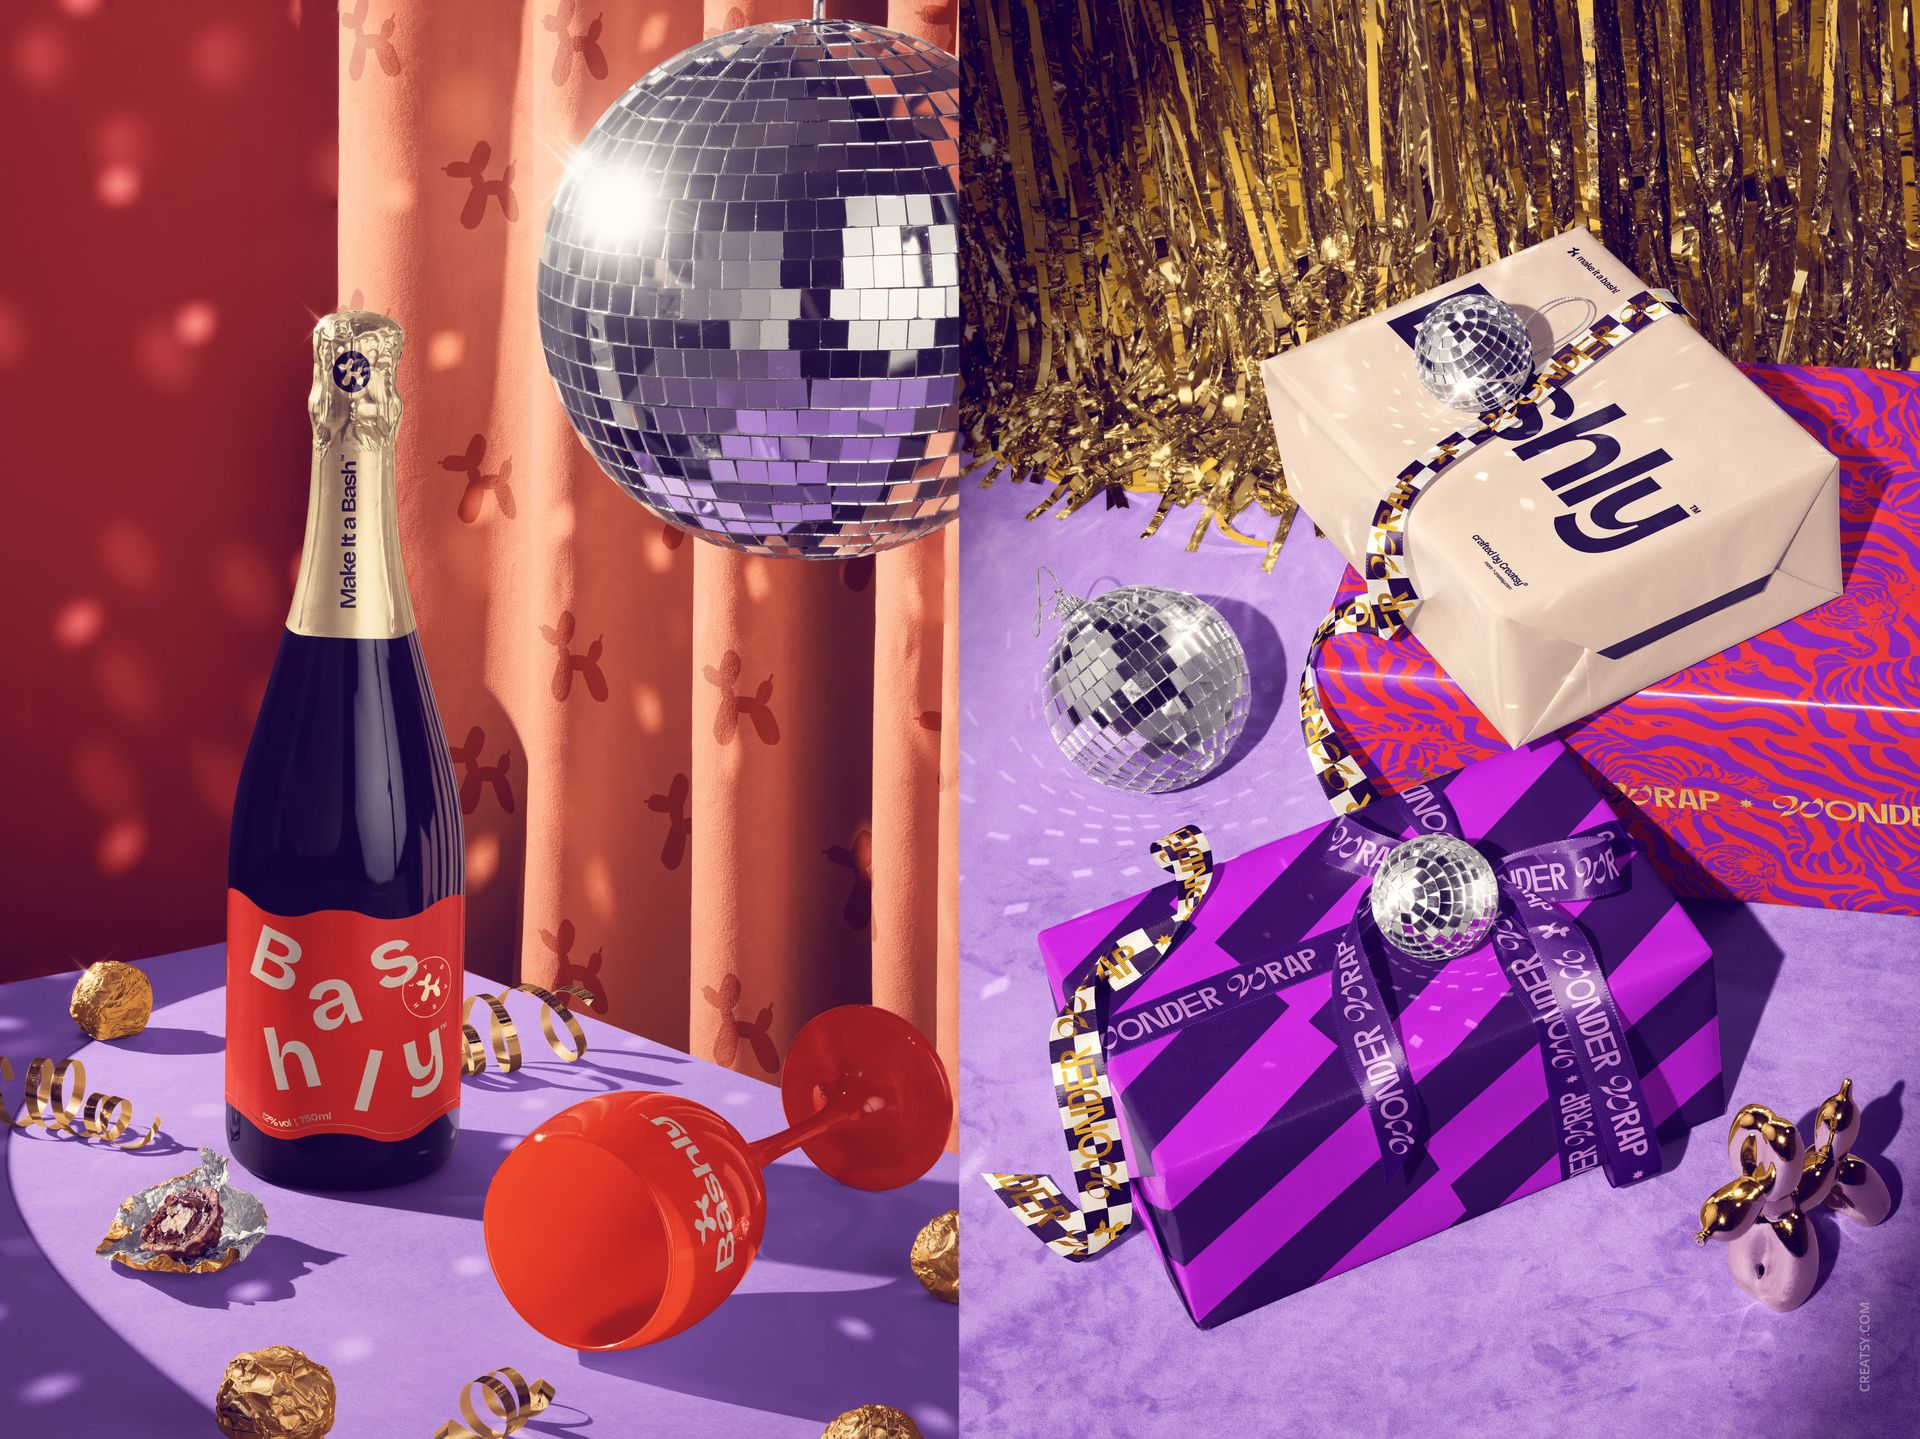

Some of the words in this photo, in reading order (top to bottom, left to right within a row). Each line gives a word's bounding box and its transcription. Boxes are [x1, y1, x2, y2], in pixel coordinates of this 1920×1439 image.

[1576, 255, 1596, 272] make
[1599, 276, 1621, 295] bash!
[341, 533, 357, 547] It
[343, 516, 357, 530] a
[1472, 534, 1498, 557] crafted
[1491, 553, 1503, 565] by
[339, 552, 357, 608] Make
[1772, 796, 1920, 829] WONDE
[1328, 826, 1391, 868] WRA
[1227, 948, 1317, 1000] WRAP
[1339, 941, 1377, 1022] WRAP
[1552, 950, 1624, 1073] WONDER
[1598, 1075, 1648, 1156] WRAP
[1353, 1024, 1416, 1155] WONDER
[1060, 1046, 1121, 1200] WONDER
